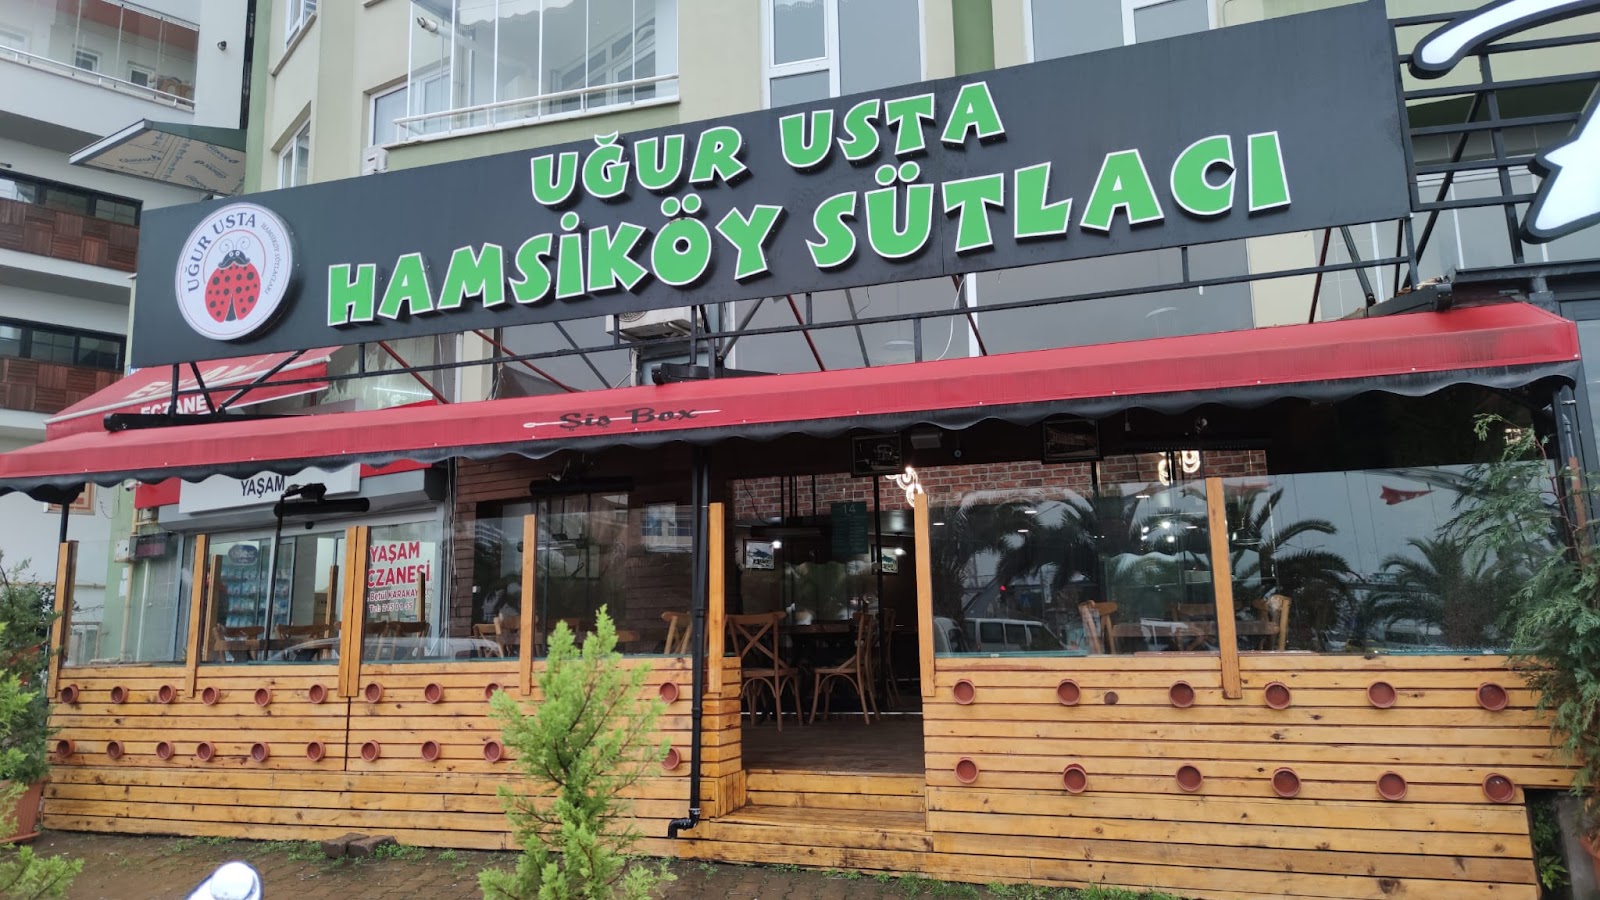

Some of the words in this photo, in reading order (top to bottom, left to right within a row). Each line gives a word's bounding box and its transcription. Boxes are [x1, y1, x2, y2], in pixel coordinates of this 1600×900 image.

[530, 125, 748, 206] UĞUR
[778, 81, 1006, 169] USTA
[184, 235, 212, 293] UĞUR
[211, 212, 257, 235] USTA
[327, 193, 784, 327] HAMSİKÖY
[805, 130, 1291, 268] SÜTLACI
[625, 406, 699, 425] Box
[240, 475, 286, 499] YAŞAM
[369, 541, 420, 565] YAŞAM
